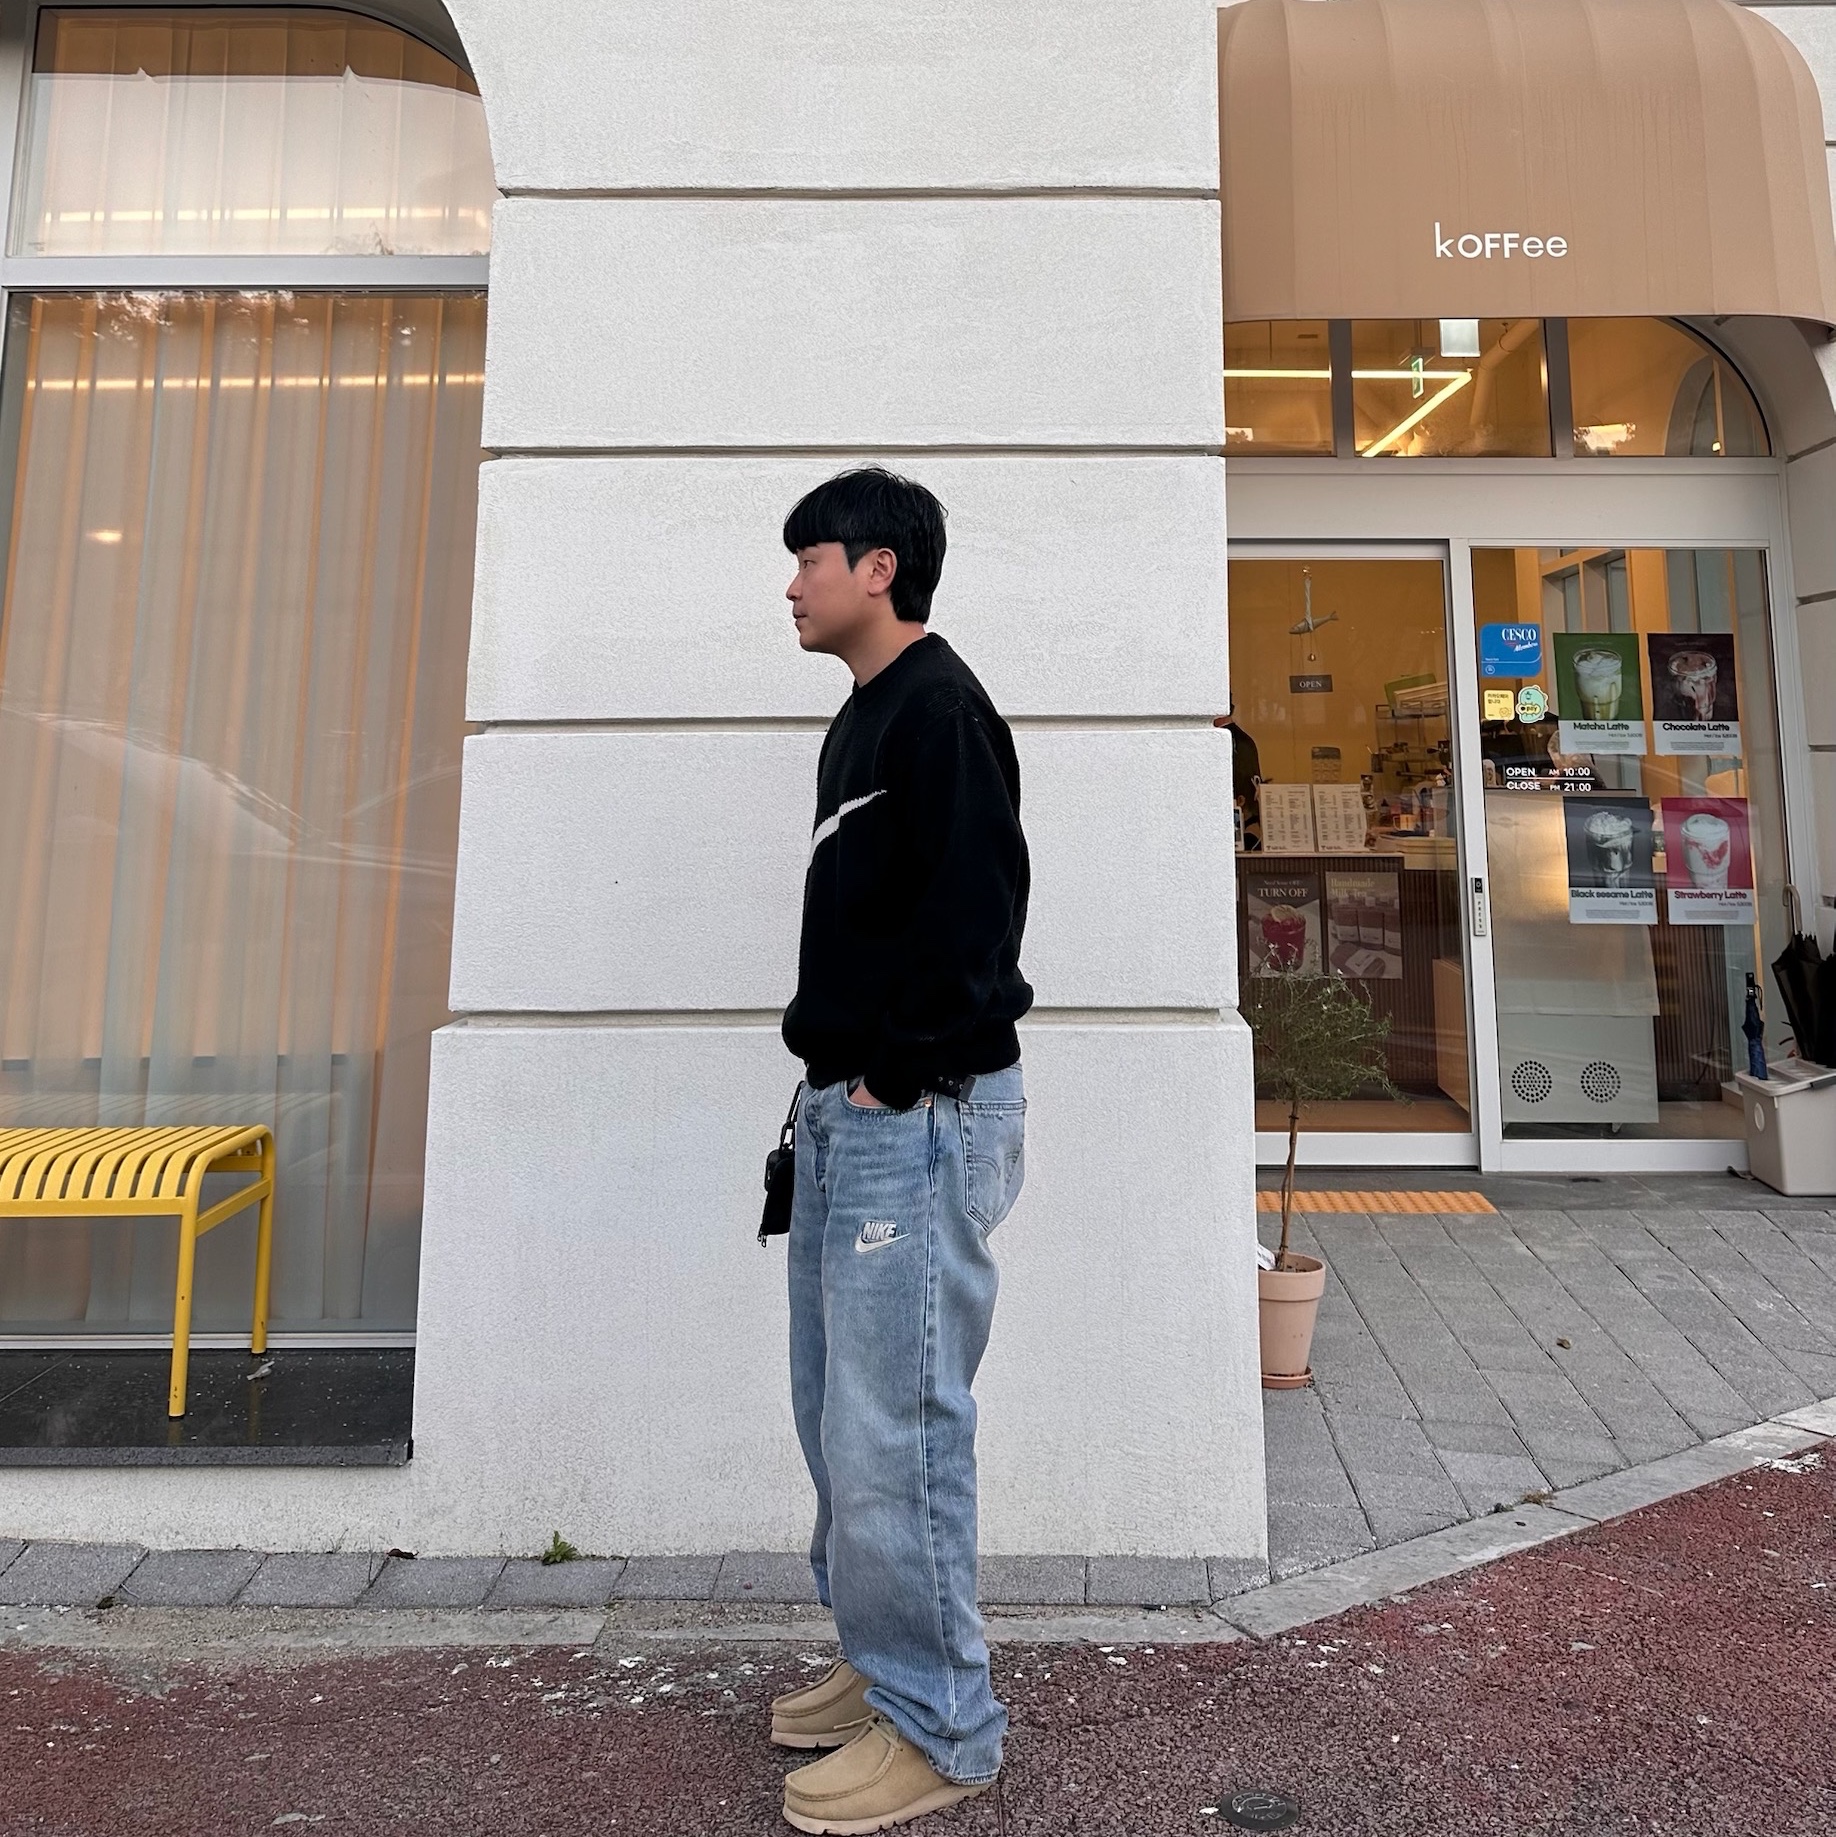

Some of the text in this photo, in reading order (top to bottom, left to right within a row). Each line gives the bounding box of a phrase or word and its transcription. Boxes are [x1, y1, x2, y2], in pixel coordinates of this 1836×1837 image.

[1501, 628, 1537, 641] CESCO
[1573, 722, 1630, 731] Matcha Latte
[1662, 722, 1730, 731] Chocolate Latte
[1506, 767, 1536, 777] OPEN
[1563, 767, 1590, 777] 10:00
[1506, 781, 1540, 790] CLOSE
[1564, 782, 1591, 792] 21:00
[1258, 888, 1308, 898] TURN OFF
[1571, 889, 1595, 898] Black
[1630, 890, 1654, 899] Latte
[1674, 891, 1748, 900] Strawberry Latte
[862, 1221, 897, 1241] NIKE
